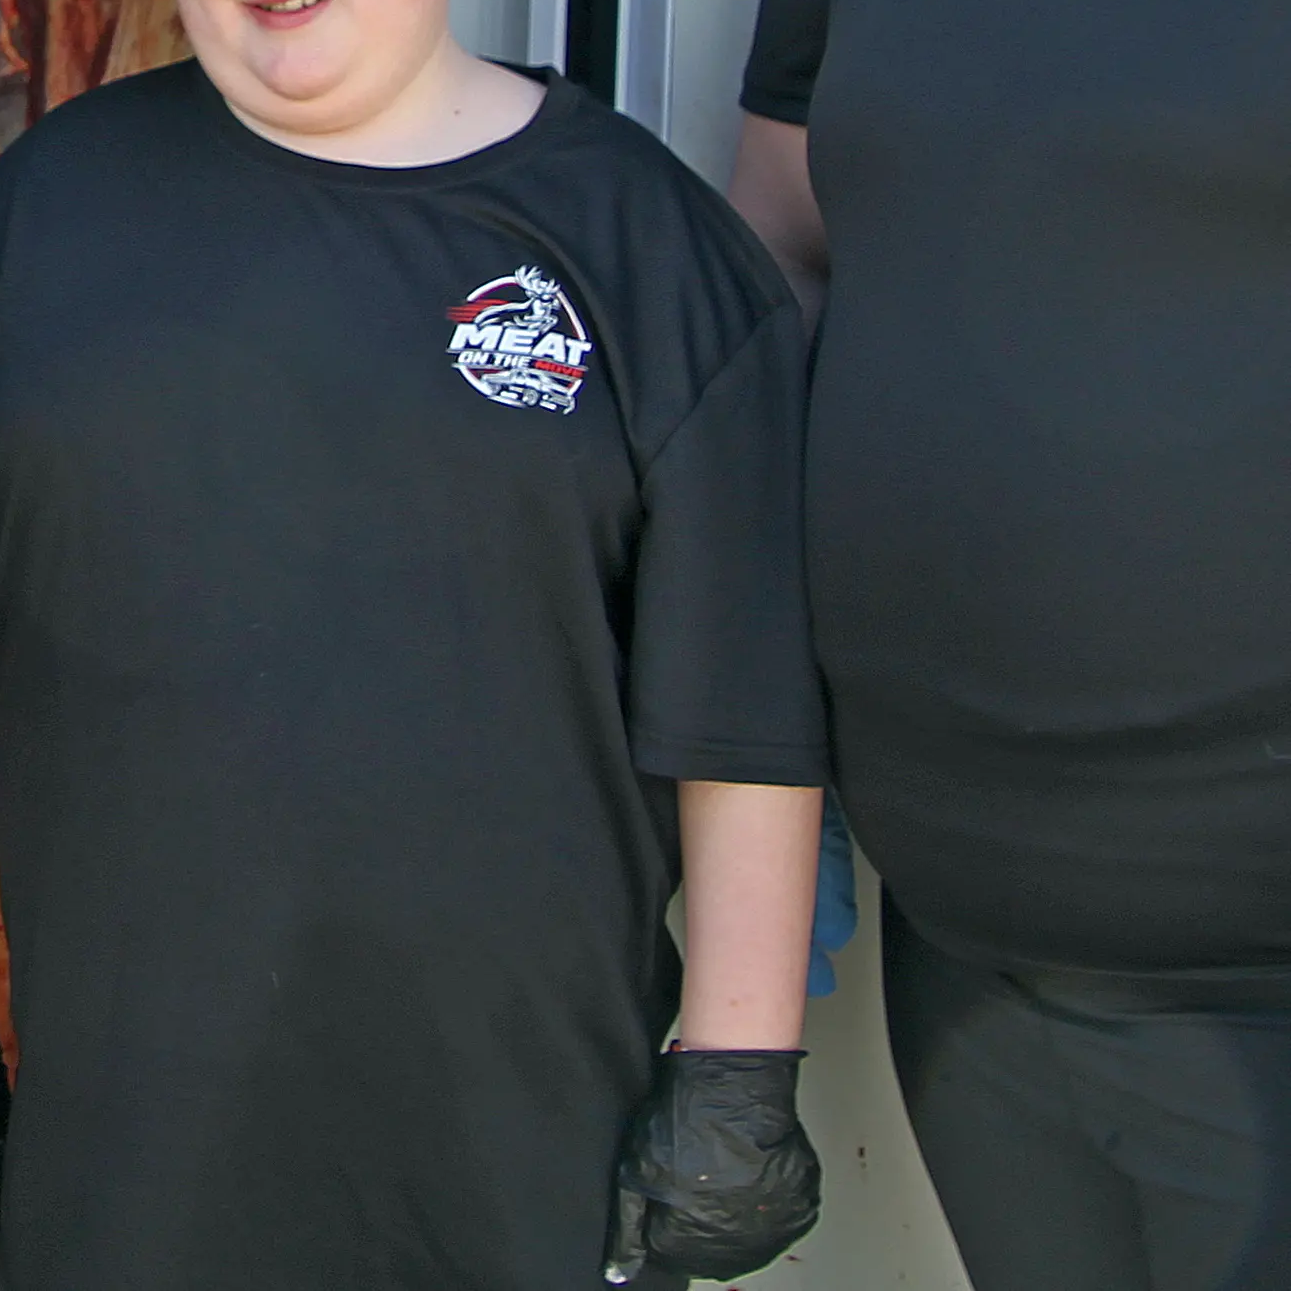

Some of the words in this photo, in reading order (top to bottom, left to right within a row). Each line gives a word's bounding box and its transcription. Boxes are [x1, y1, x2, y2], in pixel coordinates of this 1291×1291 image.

[449, 322, 593, 366] MEAT
[458, 351, 490, 364] ON
[492, 352, 533, 369] THE
